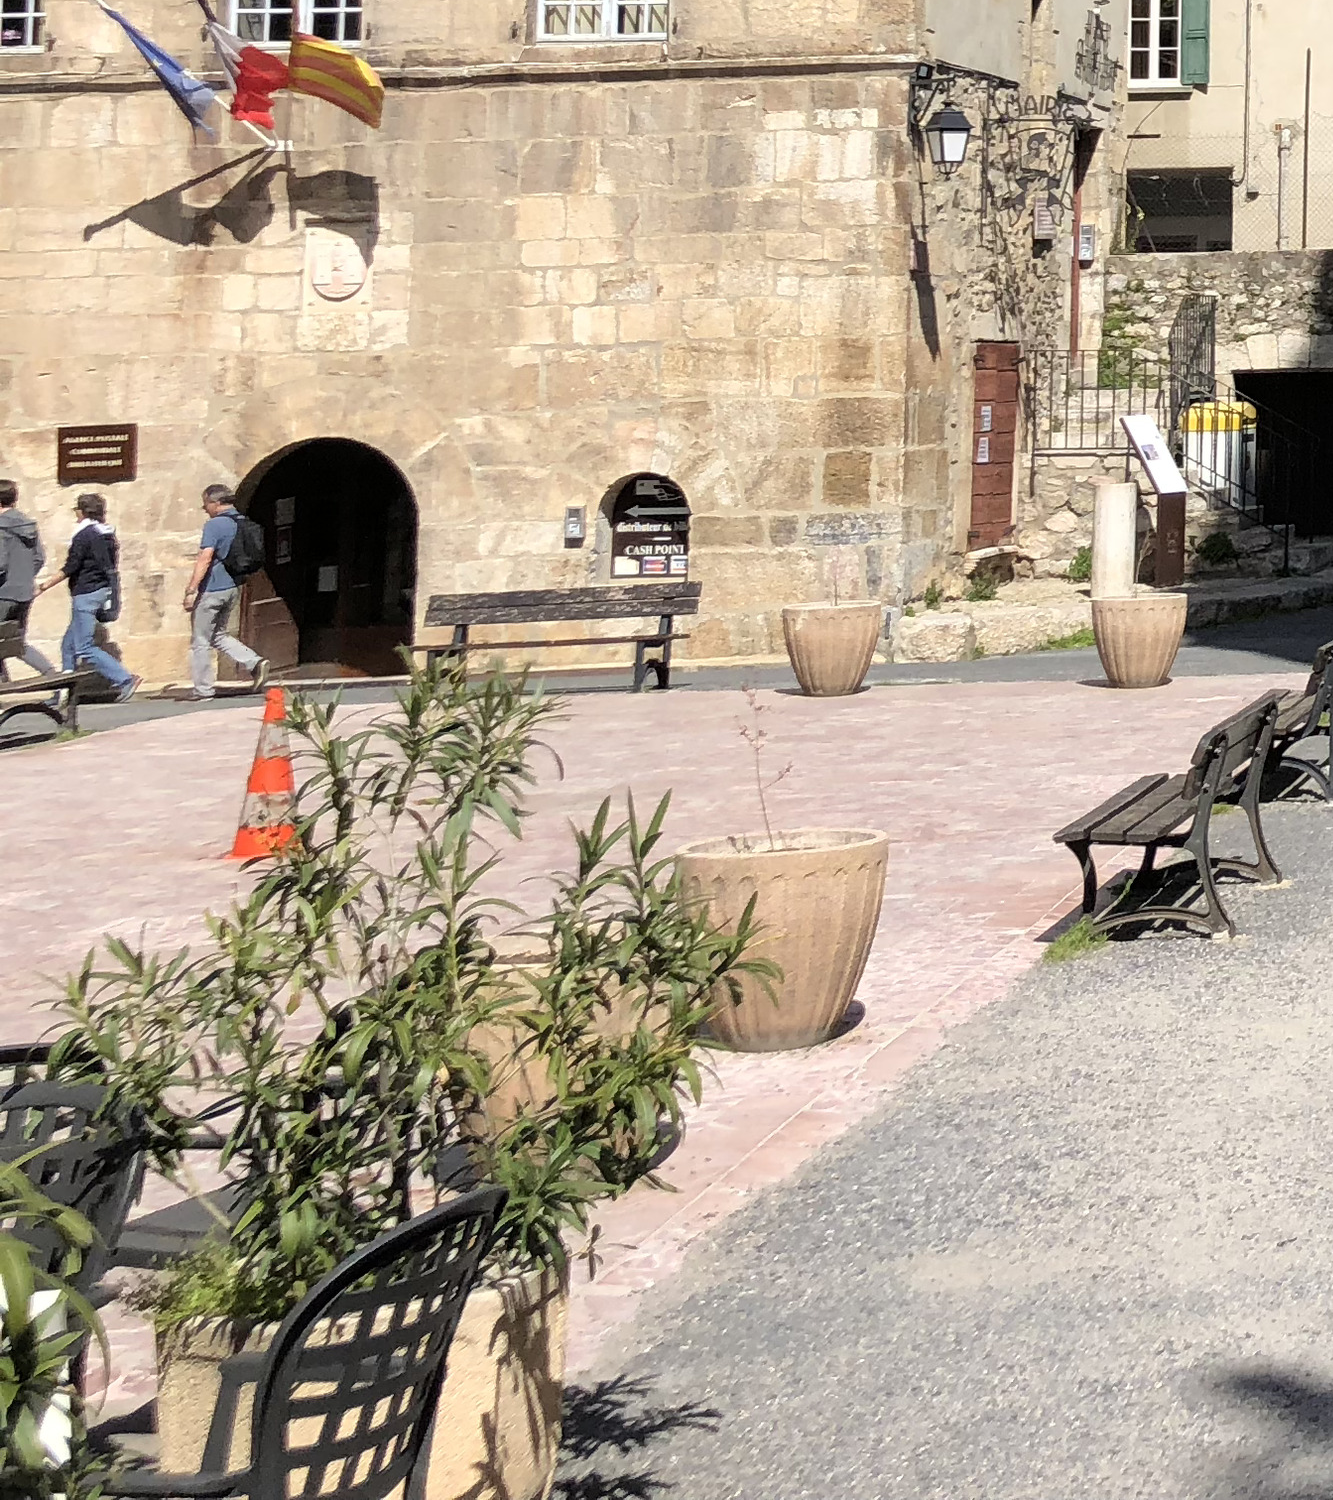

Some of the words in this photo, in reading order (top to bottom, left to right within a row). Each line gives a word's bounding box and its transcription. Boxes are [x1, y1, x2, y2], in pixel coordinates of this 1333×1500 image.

[1005, 95, 1074, 125] MAIRIE
[616, 521, 662, 532] distributeur
[625, 545, 653, 556] CASH
[655, 544, 684, 555] POINT
